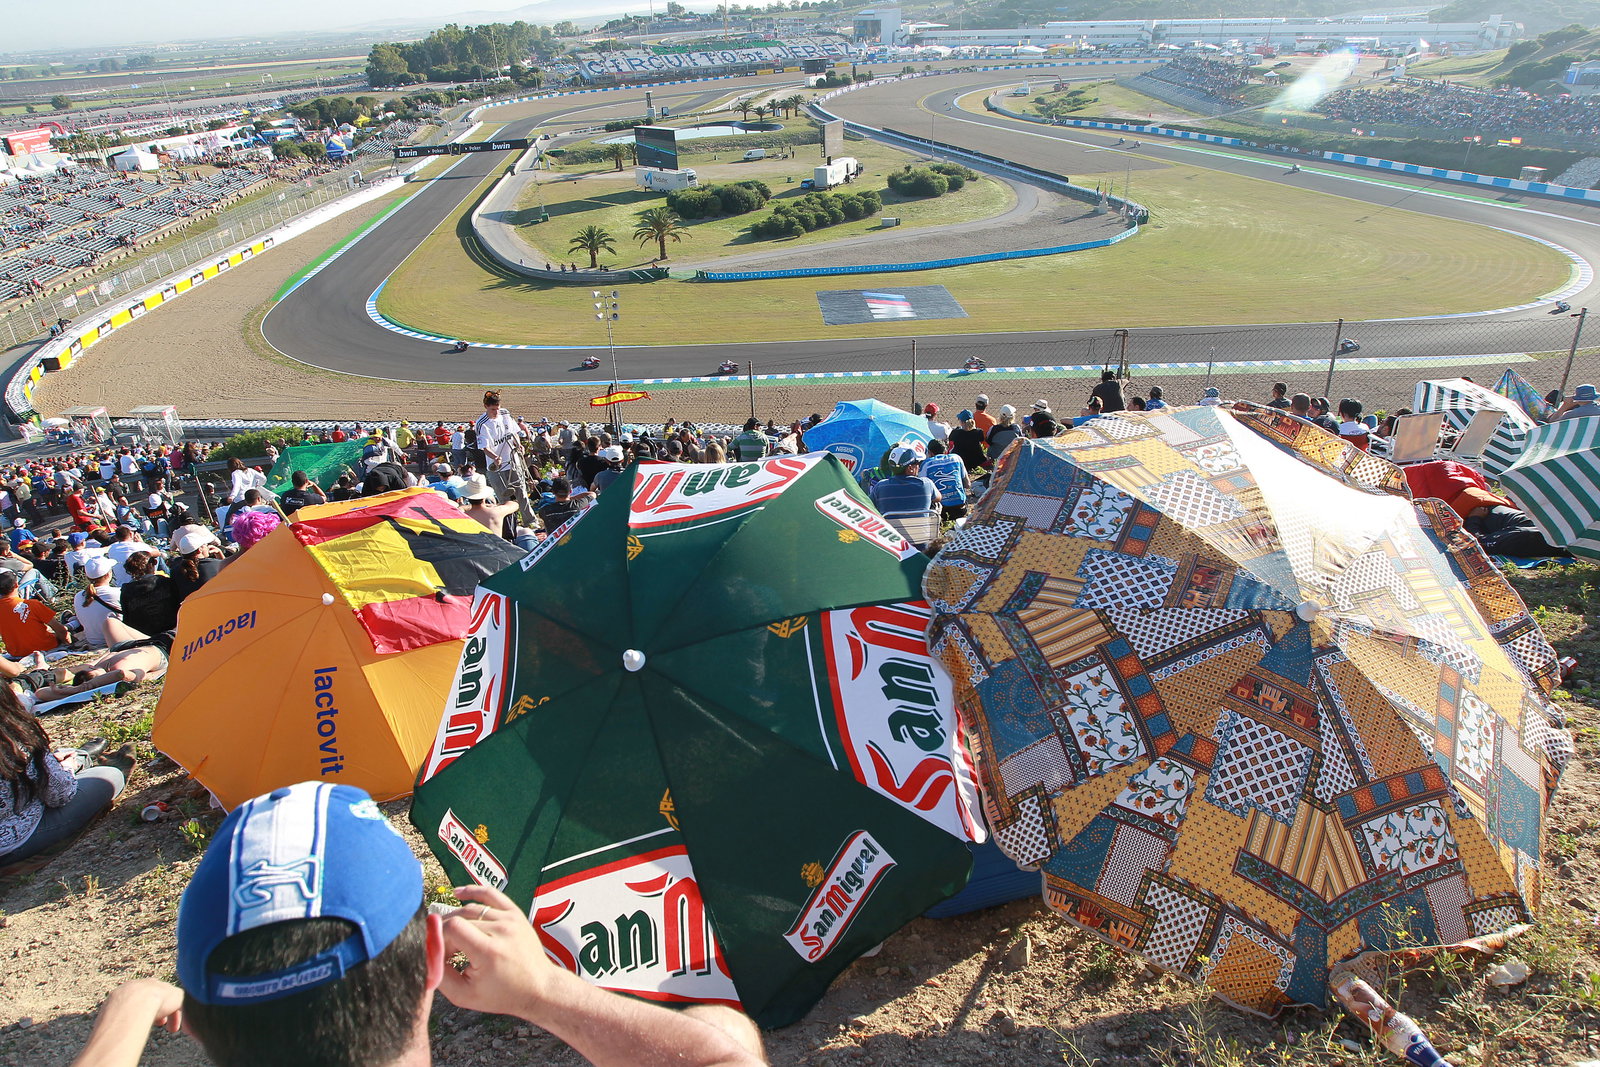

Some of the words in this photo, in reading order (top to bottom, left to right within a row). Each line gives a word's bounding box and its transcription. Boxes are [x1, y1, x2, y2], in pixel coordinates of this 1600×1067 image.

[587, 50, 737, 75] CIRCUITO
[776, 42, 857, 60] JEREZ
[399, 149, 418, 157] bwin
[492, 142, 511, 150] bwin
[182, 610, 257, 662] lactovit
[314, 666, 344, 776] lactovit
